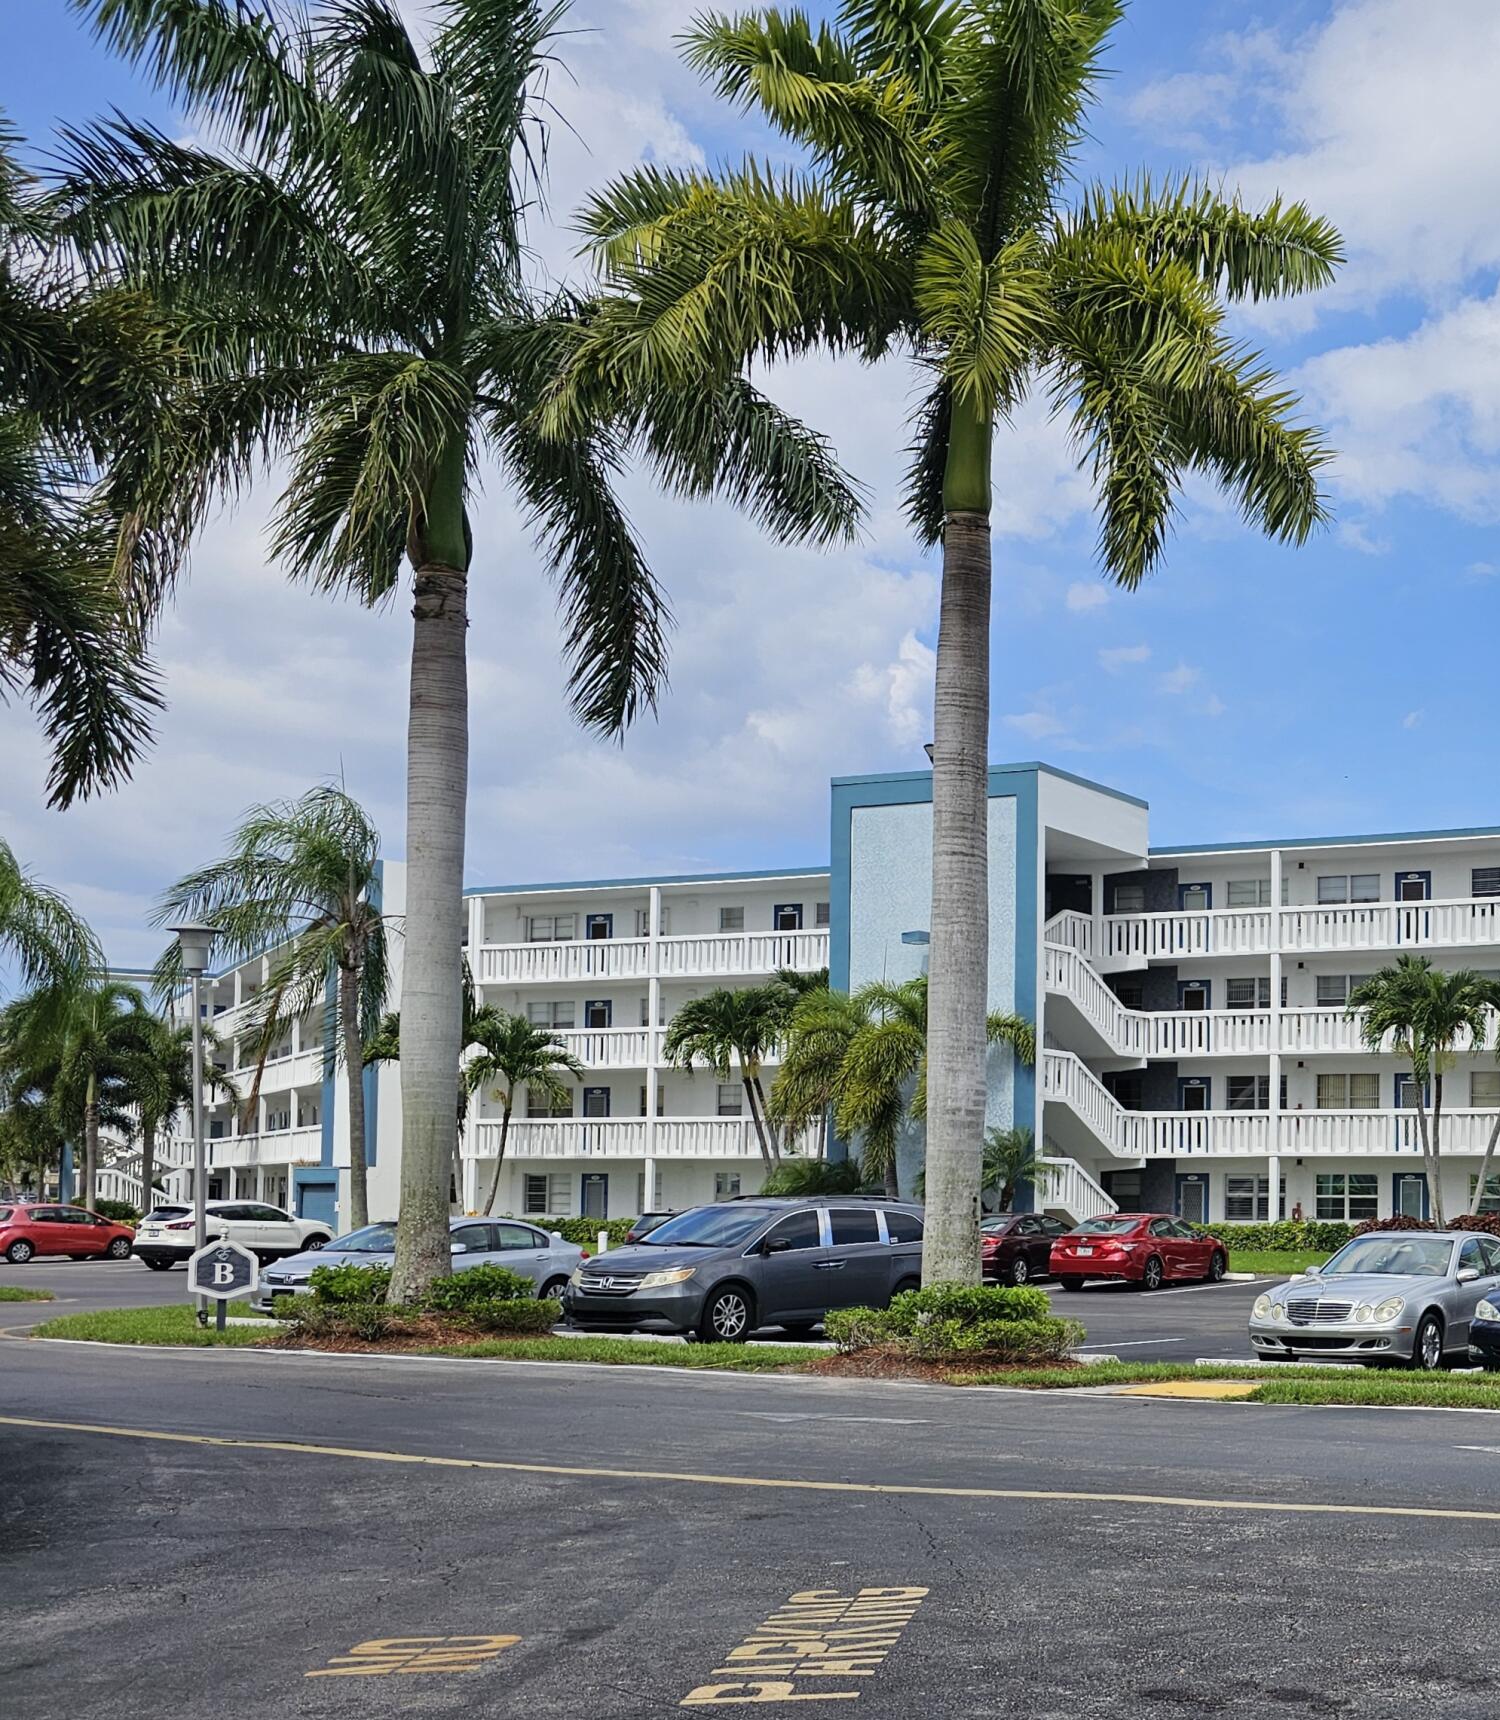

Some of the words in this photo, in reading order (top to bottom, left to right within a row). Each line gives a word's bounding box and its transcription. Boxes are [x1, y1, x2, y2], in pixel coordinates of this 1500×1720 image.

[212, 1263, 235, 1285] B
[304, 1635, 522, 1677] NO
[680, 1587, 930, 1705] PARKING
